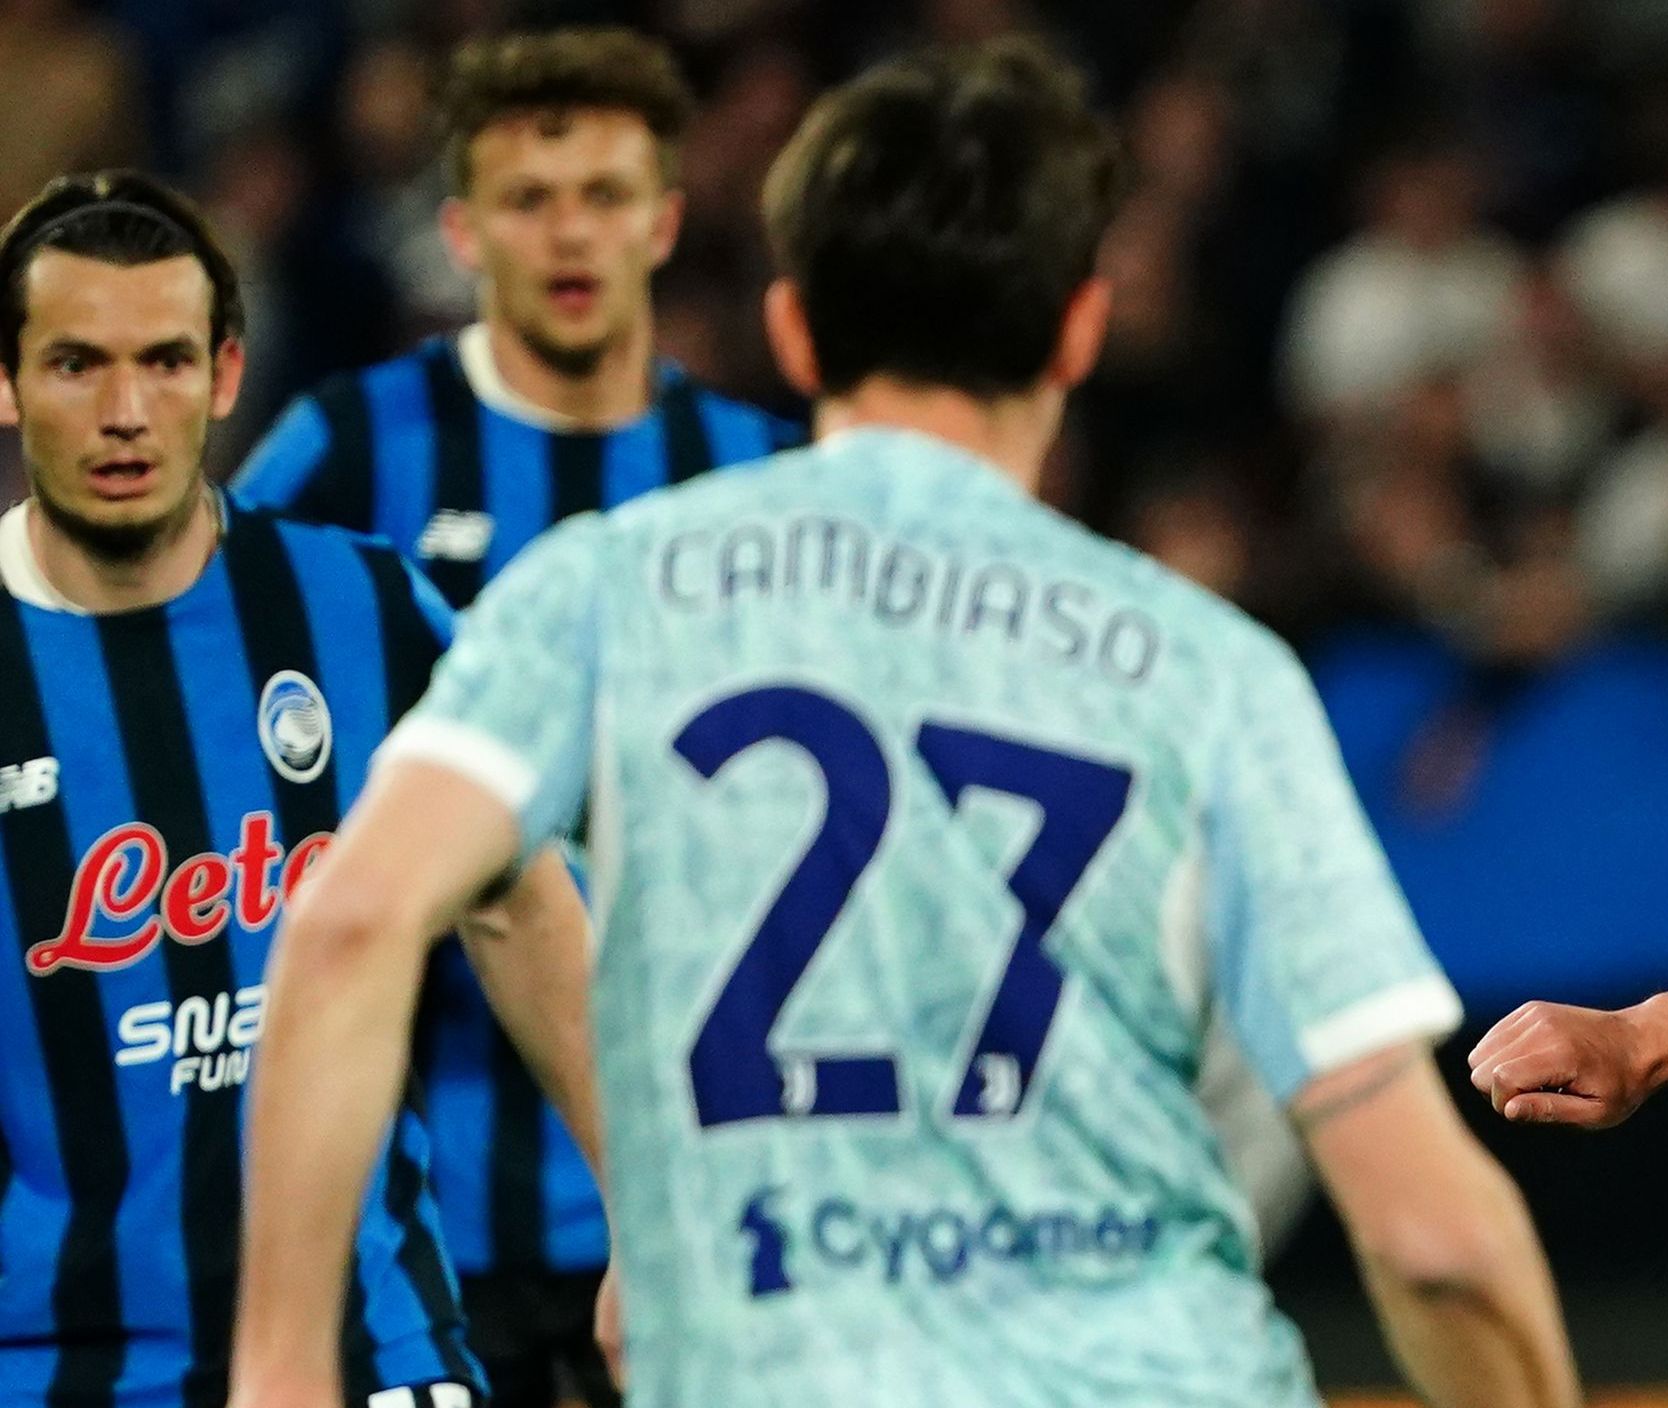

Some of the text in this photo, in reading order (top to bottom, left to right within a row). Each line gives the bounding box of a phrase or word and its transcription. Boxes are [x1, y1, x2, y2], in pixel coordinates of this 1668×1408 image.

[659, 517, 1162, 684] CAMBIASO
[672, 685, 1135, 1129] 27
[115, 985, 269, 1067] SNA
